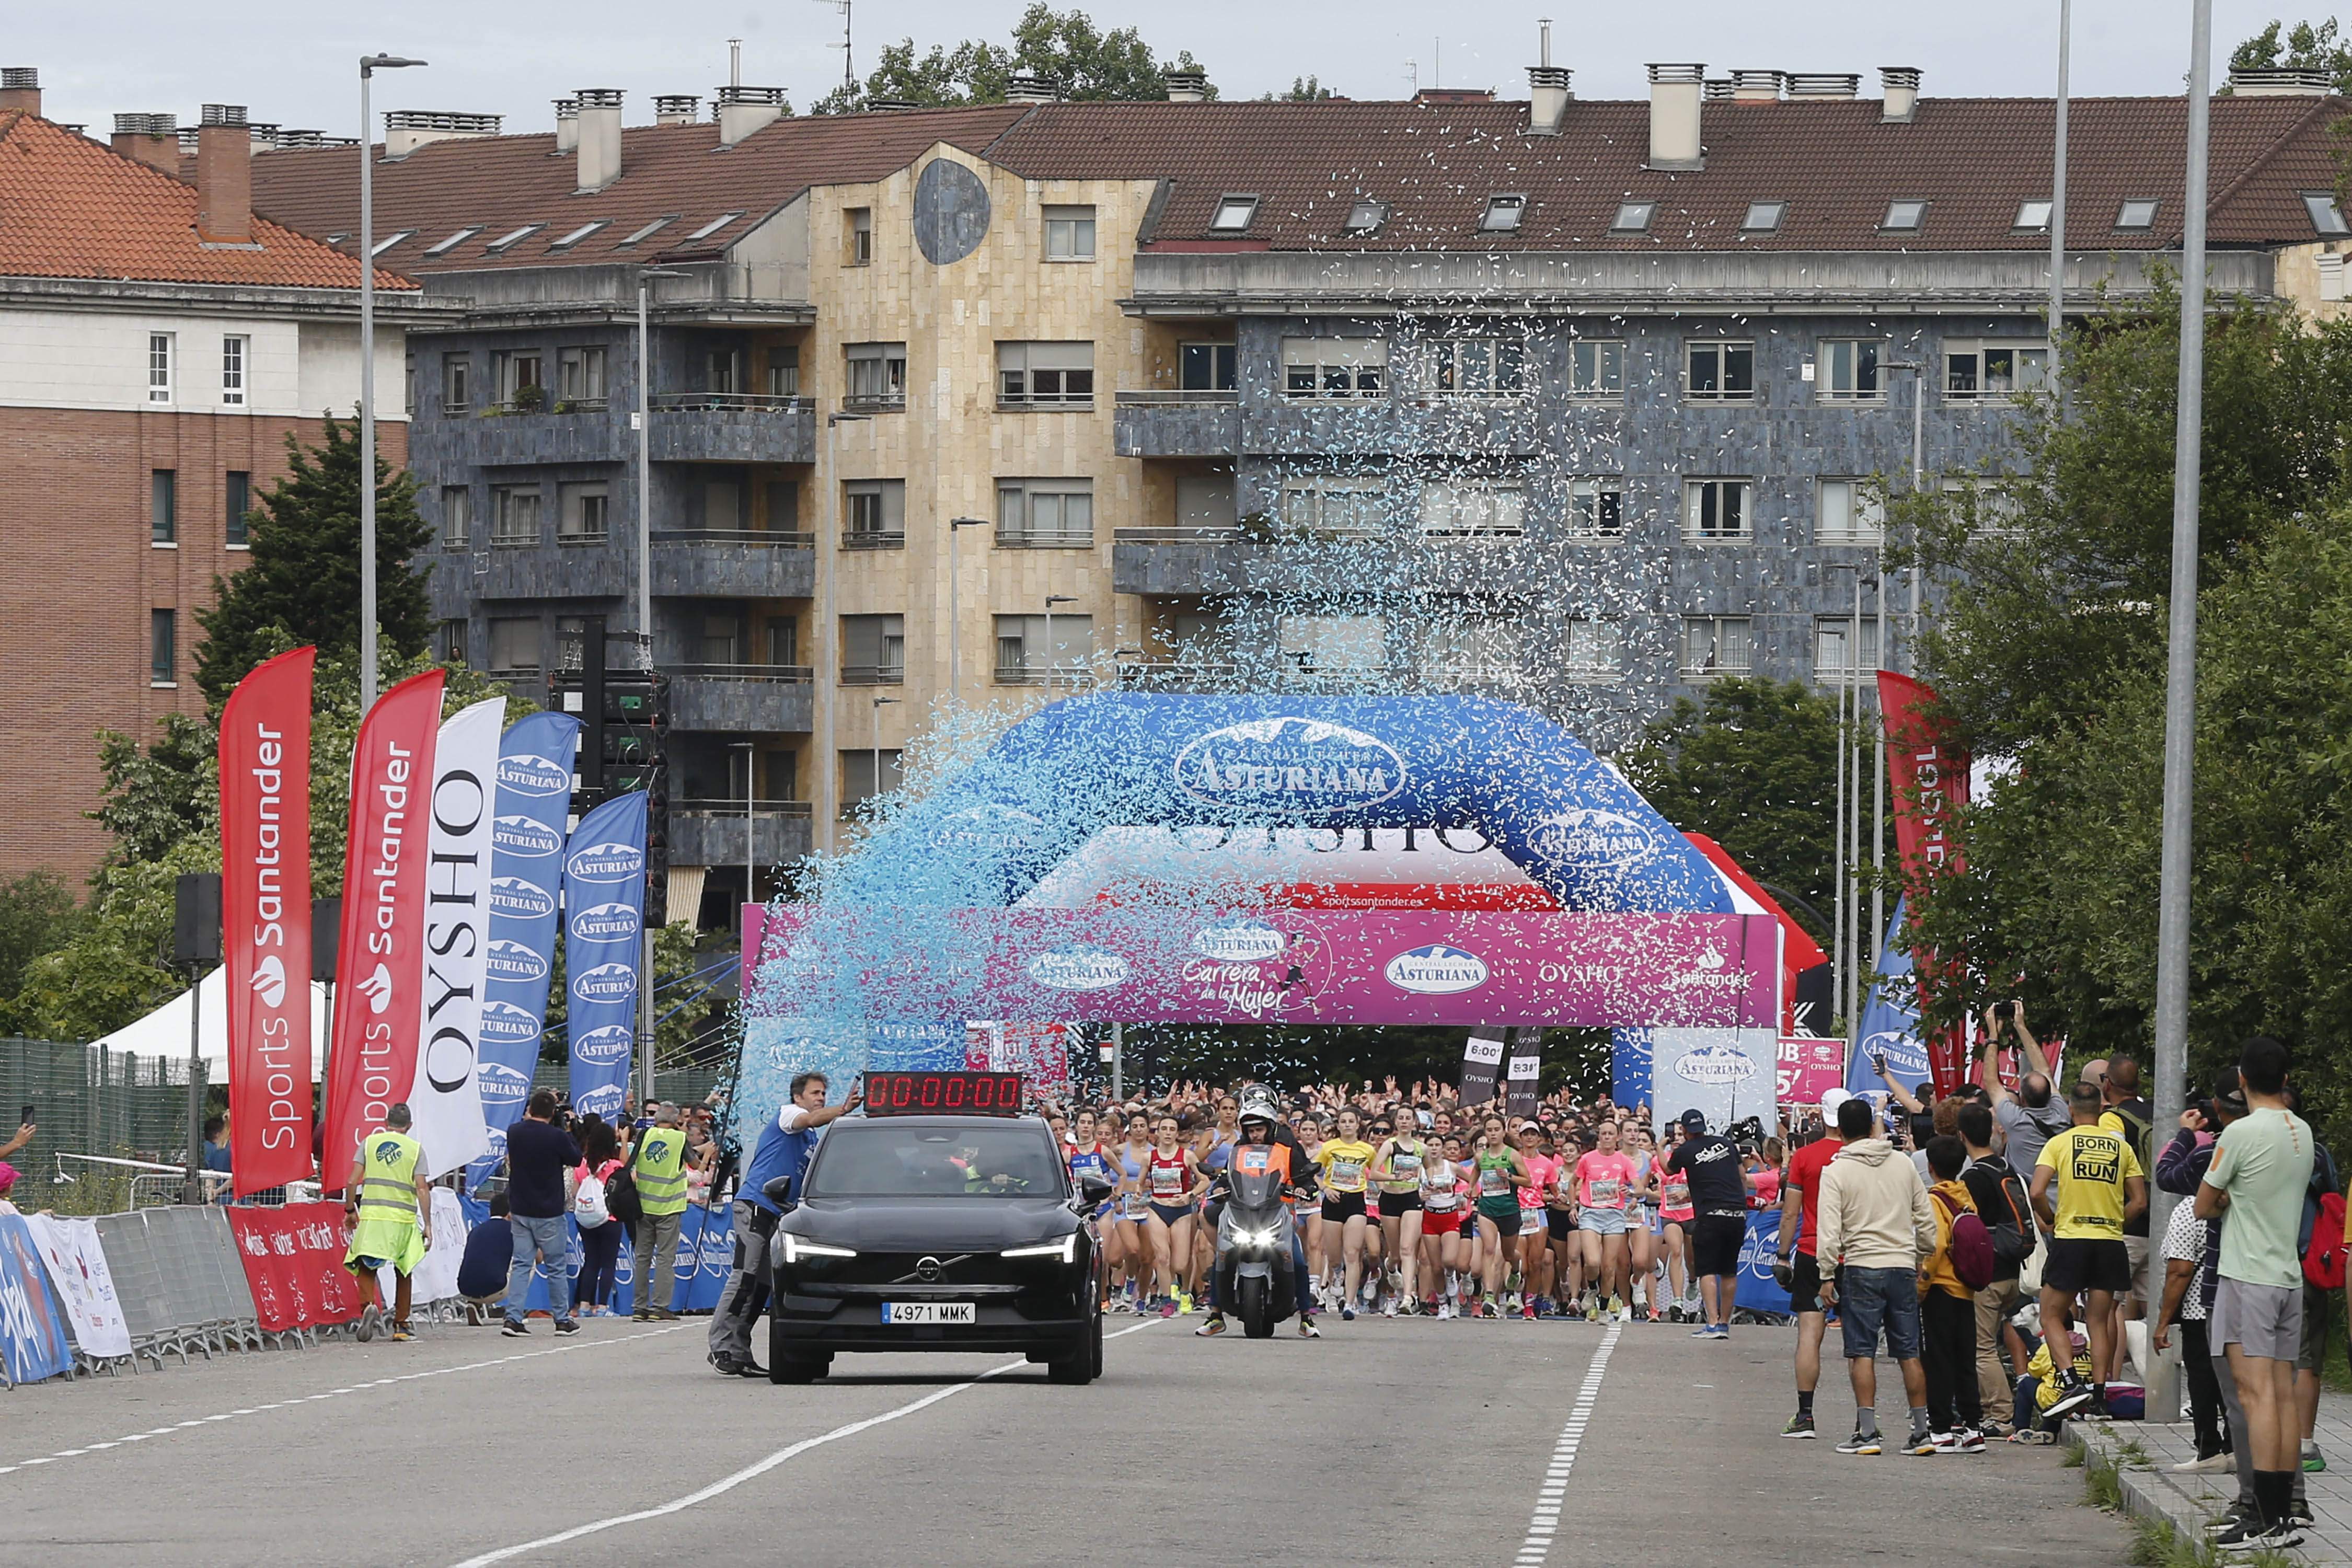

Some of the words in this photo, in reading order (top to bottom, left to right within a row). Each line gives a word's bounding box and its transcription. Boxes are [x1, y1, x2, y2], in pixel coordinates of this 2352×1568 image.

[1191, 749, 1388, 792] ASTURIANA
[252, 722, 283, 948] Santander
[493, 832, 554, 850] STURIANA
[369, 741, 411, 955] Santander
[490, 894, 547, 912] STURIANA
[1322, 896, 1422, 907] sportssantander.es
[425, 769, 483, 1093] OYSHO
[488, 959, 540, 975] TURIANA
[1182, 960, 1261, 983] Carrera
[1393, 962, 1481, 981] ASTURIANA
[1539, 965, 1621, 983] OYSHO
[1671, 971, 1750, 986] Santander
[1220, 979, 1290, 1019] Mujer
[480, 1020, 534, 1036] TURIANA
[1681, 1060, 1750, 1075] ASTURIANA
[258, 1016, 302, 1150] Sports
[1465, 1074, 1494, 1084] OYSHO
[479, 1081, 526, 1097] TURIANA
[868, 1077, 1019, 1108] 00:00:00
[1509, 1092, 1535, 1100] OYSHO
[377, 1144, 396, 1160] Sport
[2076, 1137, 2117, 1152] BORN
[384, 1150, 402, 1166] Life
[653, 1149, 670, 1164] Life
[2076, 1163, 2115, 1181] RUN
[894, 1306, 932, 1321] 4971
[940, 1306, 969, 1321] MMK
